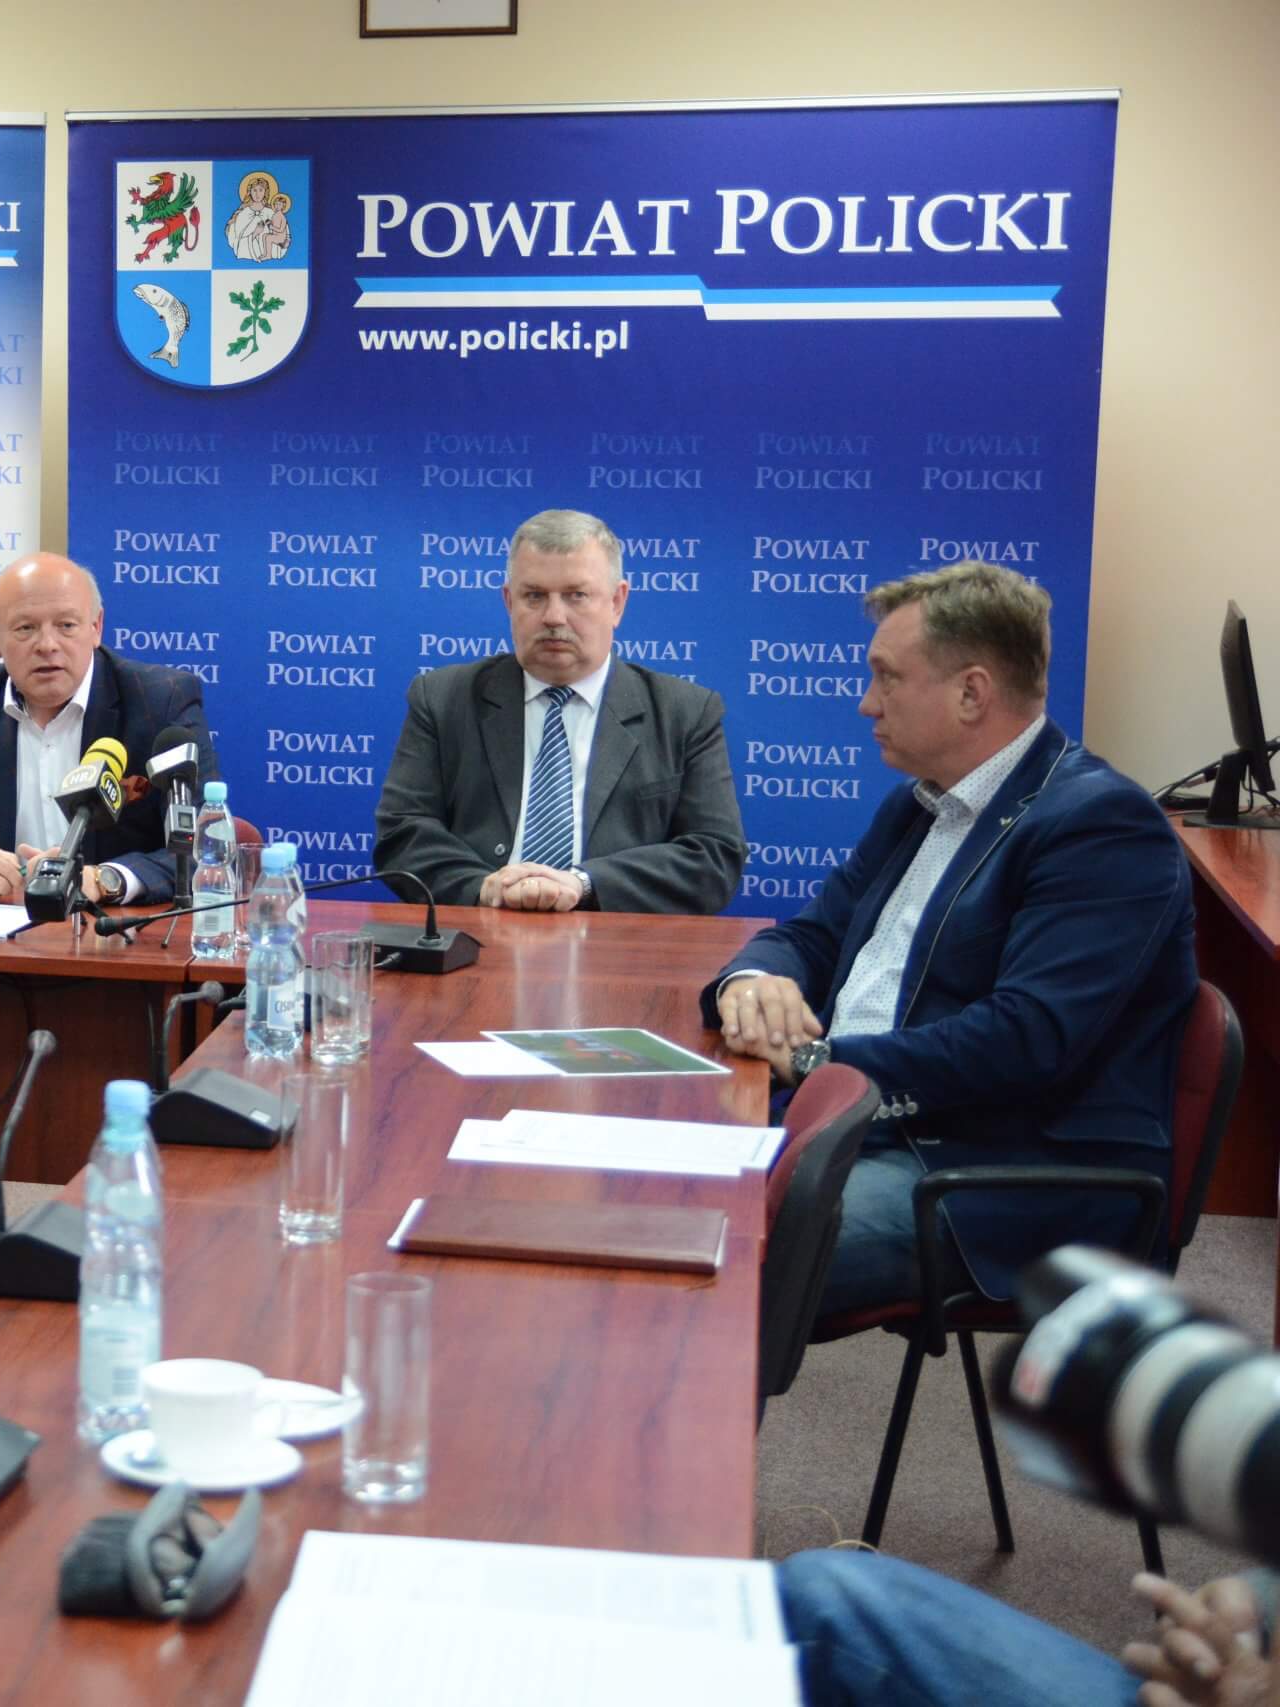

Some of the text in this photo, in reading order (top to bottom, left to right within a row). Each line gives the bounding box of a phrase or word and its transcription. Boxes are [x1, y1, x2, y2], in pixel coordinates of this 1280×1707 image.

[356, 188, 1072, 258] POWIAT POLICKI
[358, 320, 629, 358] www.policki.pl
[114, 430, 219, 453] POWIAT
[271, 431, 378, 454] POWIAT
[424, 432, 532, 455] POWIAT
[590, 433, 703, 456] POWIAT
[757, 432, 873, 456] POWIAT
[925, 433, 1042, 456] POWIAT
[113, 463, 220, 486] POLICKI
[270, 464, 378, 487] POLICKI
[422, 465, 533, 488] POLICKI
[588, 465, 703, 489] POLICKI
[755, 465, 872, 489] POLICKI
[923, 466, 1042, 491] POLICKI
[114, 529, 220, 553] POWIAT
[269, 531, 378, 555] POWIAT
[421, 533, 511, 556] POWIA
[620, 538, 700, 558] WIAT
[753, 536, 870, 560] POWIAT
[920, 537, 1040, 561] POWIAT
[113, 562, 219, 585] POLICKI
[268, 564, 377, 588] POLICKI
[420, 566, 508, 589] POLIC
[625, 571, 700, 592] LICKI
[751, 570, 869, 593] POLICKI
[113, 628, 220, 651] POWIAT
[269, 630, 376, 655] POWIAT
[418, 634, 511, 657] POWIA
[611, 640, 697, 661] WIAT
[749, 639, 866, 664] POWIAT
[267, 663, 375, 687] POLICKI
[747, 672, 865, 697] POLICKI
[266, 729, 375, 754] POWIAT
[745, 741, 862, 766] POWIAT
[266, 761, 374, 786] POLICKI
[743, 774, 861, 799] POLICKI
[296, 863, 373, 883] LICKI
[741, 875, 825, 898] POLIC
